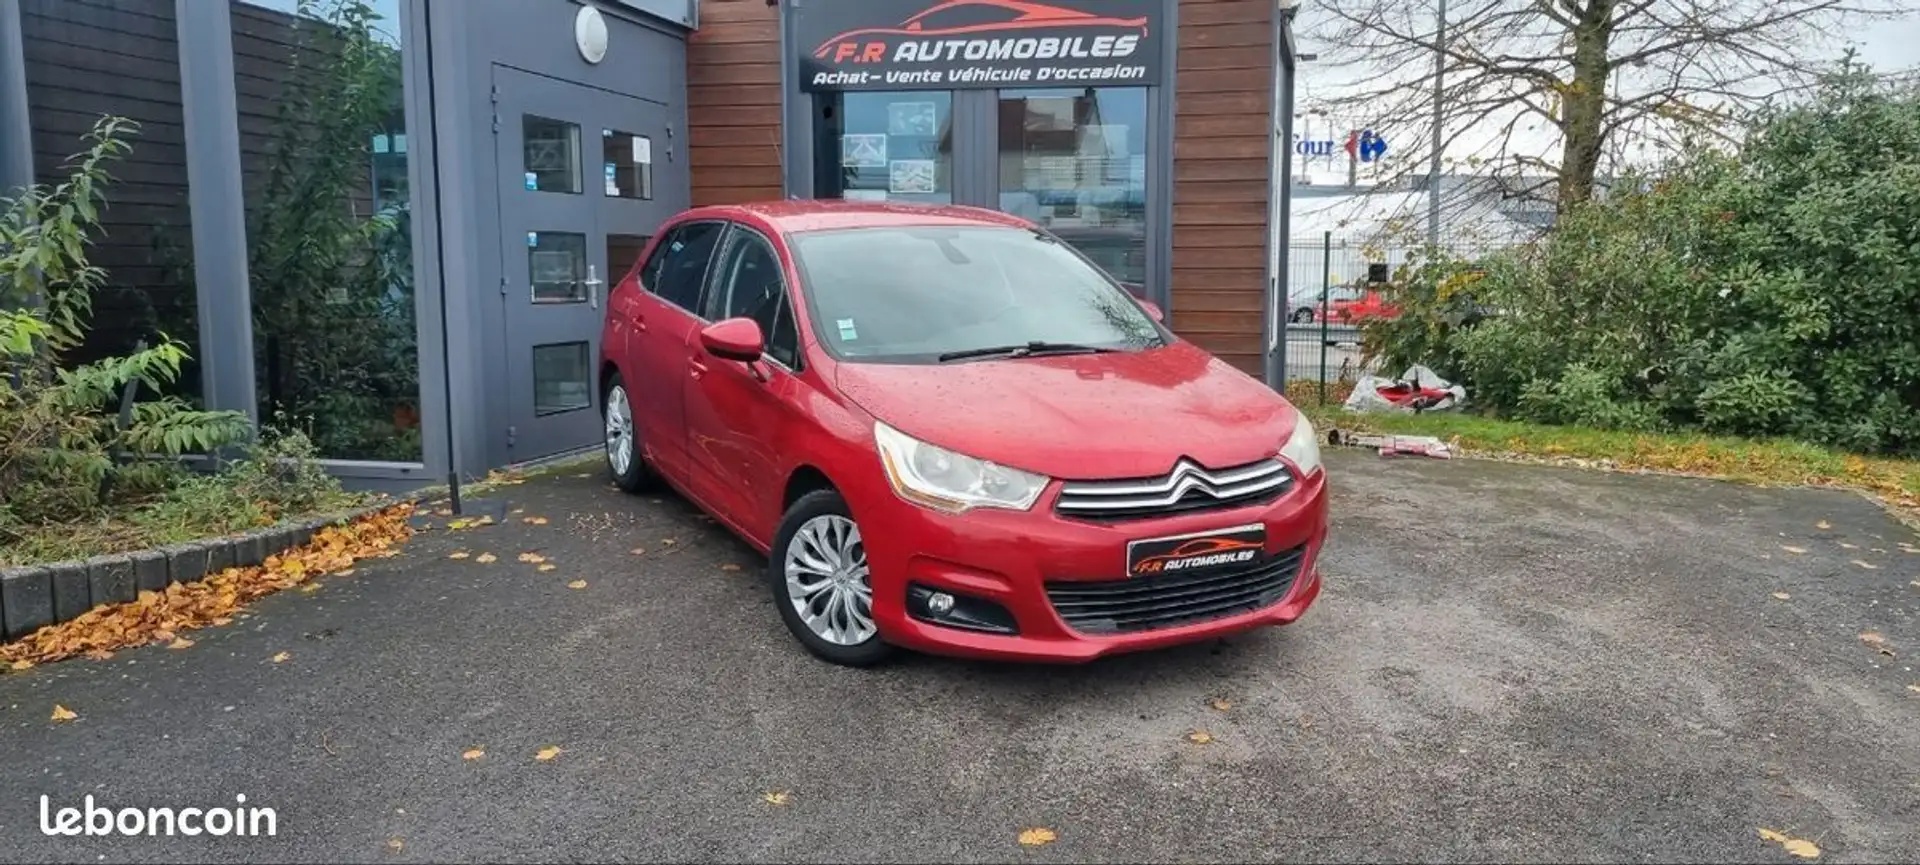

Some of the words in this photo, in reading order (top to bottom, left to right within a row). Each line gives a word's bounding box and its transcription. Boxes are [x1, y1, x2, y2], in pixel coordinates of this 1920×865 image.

[834, 42, 888, 64] F.R
[893, 34, 1139, 63] AUTOMOBILES
[882, 68, 942, 84] Vente
[948, 65, 1031, 82] Véhicule
[1036, 64, 1146, 81] D'occasion
[1140, 561, 1162, 573] F.R
[1164, 550, 1255, 571] AUTOMOBILES
